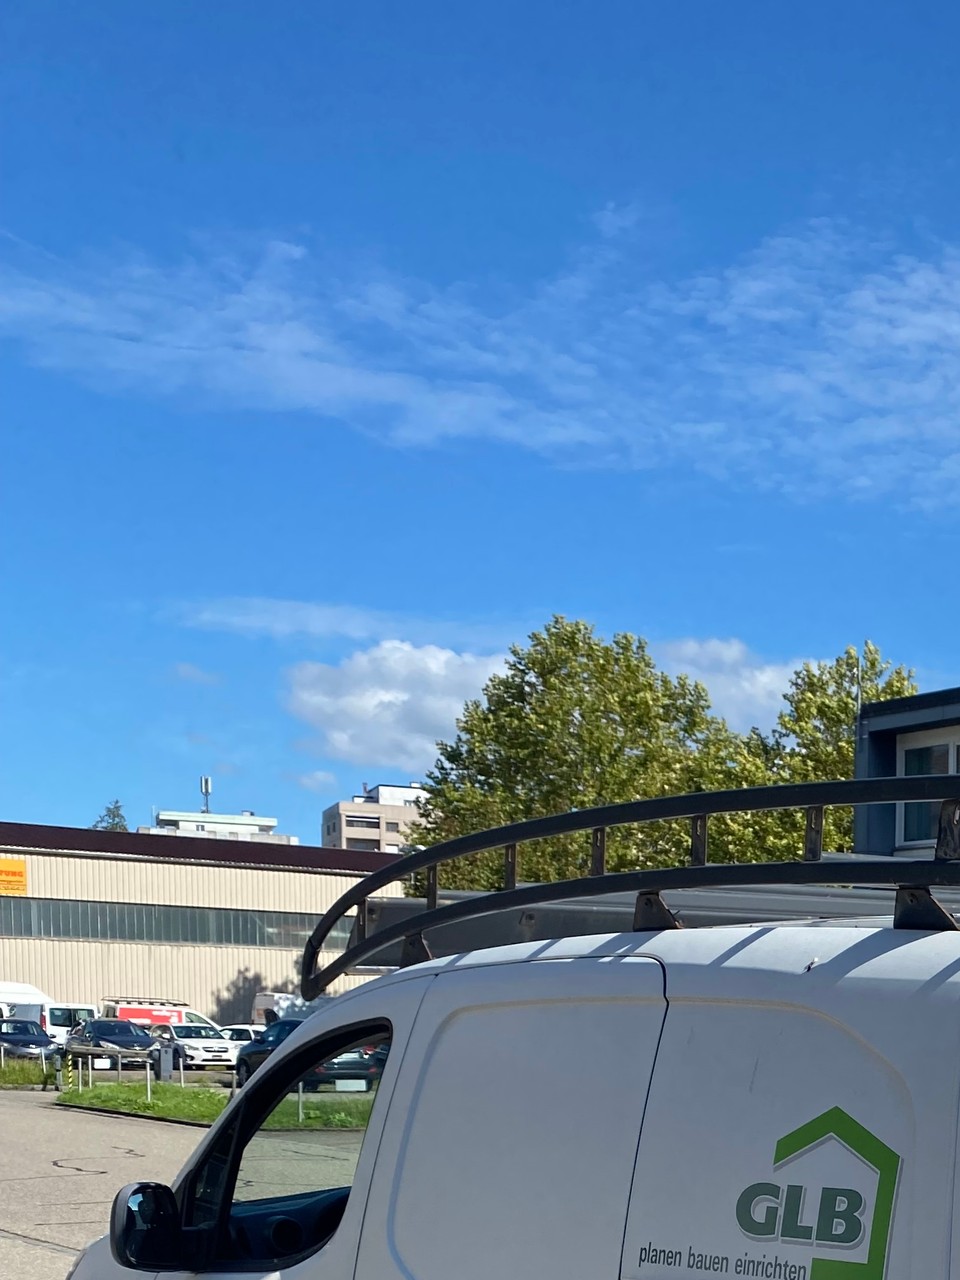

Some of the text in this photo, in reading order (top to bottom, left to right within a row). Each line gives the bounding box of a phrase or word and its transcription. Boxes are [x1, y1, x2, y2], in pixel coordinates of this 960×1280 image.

[735, 1181, 866, 1250] GLB
[638, 1241, 682, 1268] planen
[687, 1246, 729, 1273] bauen
